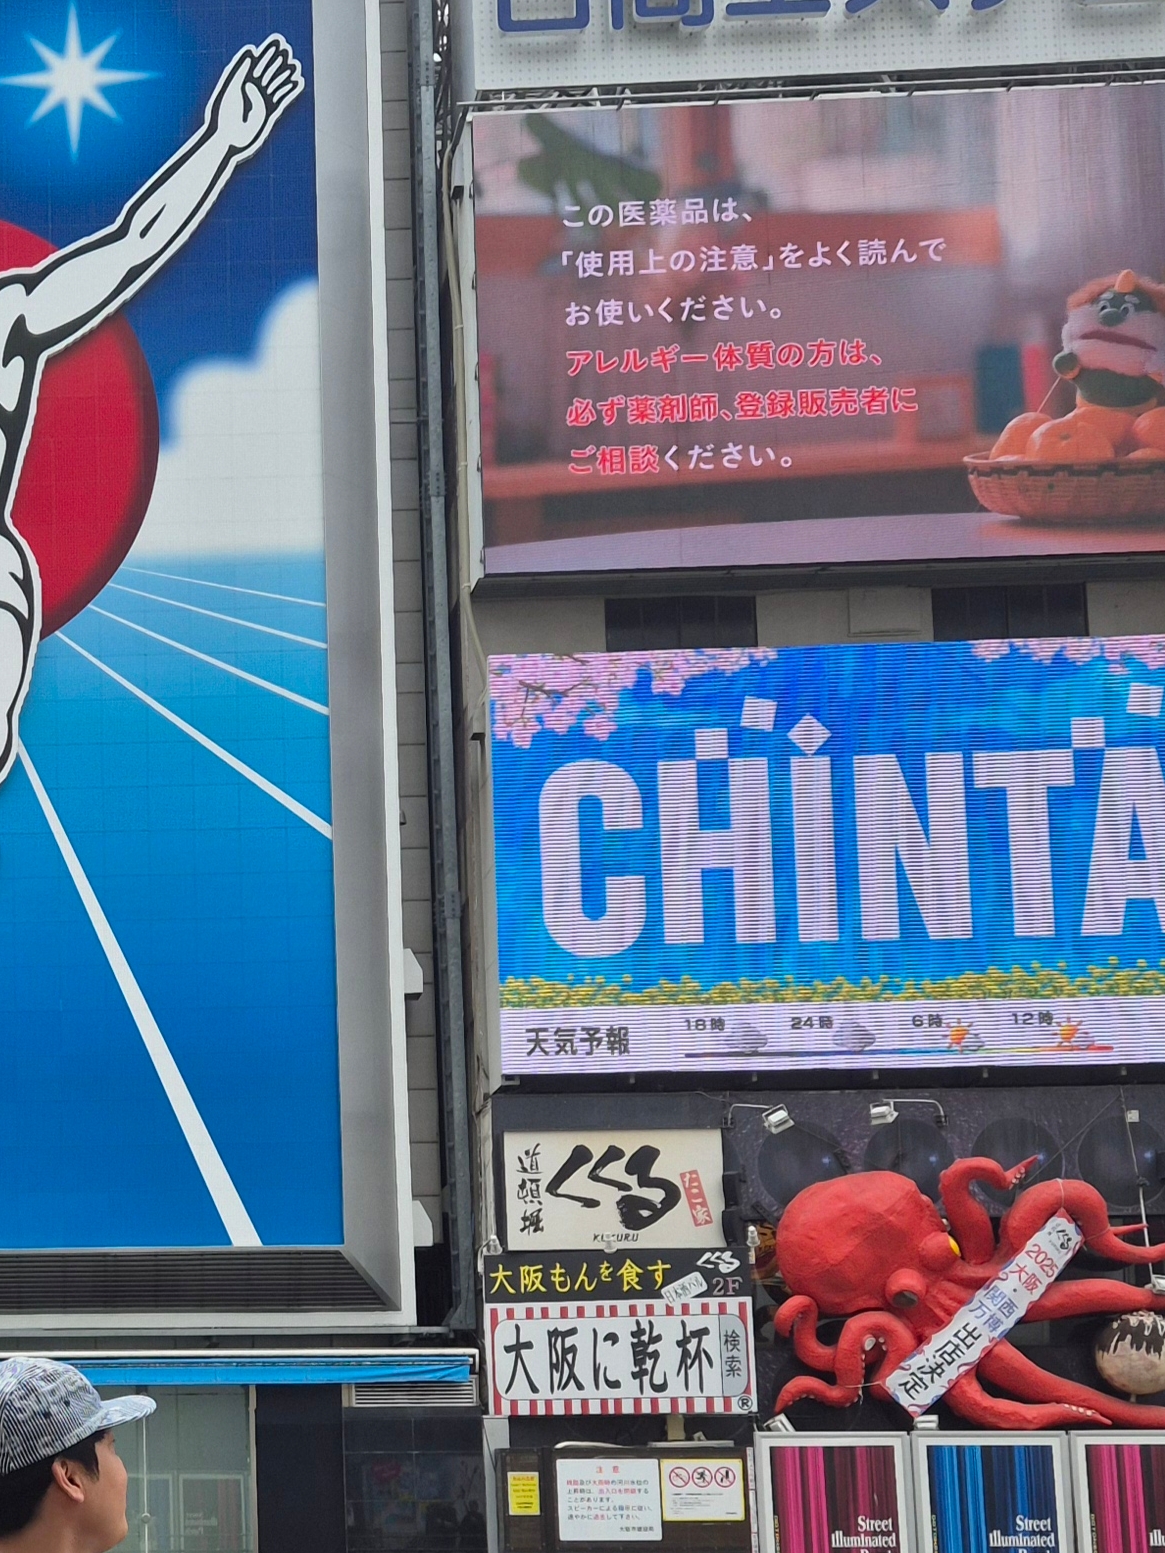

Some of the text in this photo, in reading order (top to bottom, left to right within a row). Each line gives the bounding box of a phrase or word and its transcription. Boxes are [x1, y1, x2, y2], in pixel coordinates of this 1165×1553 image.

[562, 197, 753, 229] この医薬品は、
[561, 238, 947, 279] 「使用上の注意」をよく読んで
[565, 296, 783, 327] お使いください。
[567, 338, 883, 377] アレルギー体質の方は、
[567, 386, 919, 427] 必ず薬剤師、登録販売者に
[569, 444, 794, 476] ご相談ください。
[525, 1026, 630, 1056] 天気予報
[516, 1143, 544, 1236] 道頓堀
[545, 1144, 682, 1231] くくる
[489, 1258, 672, 1295] 大阪もんを食す
[696, 1250, 742, 1274] くくる
[1024, 1243, 1059, 1279] 2025
[712, 1276, 743, 1296] 2F
[503, 1319, 714, 1395] 大阪に乾杯
[723, 1328, 742, 1378] 検索
[898, 1321, 982, 1401] 出店決定
[857, 1515, 893, 1532] Street
[1016, 1515, 1052, 1531] Street
